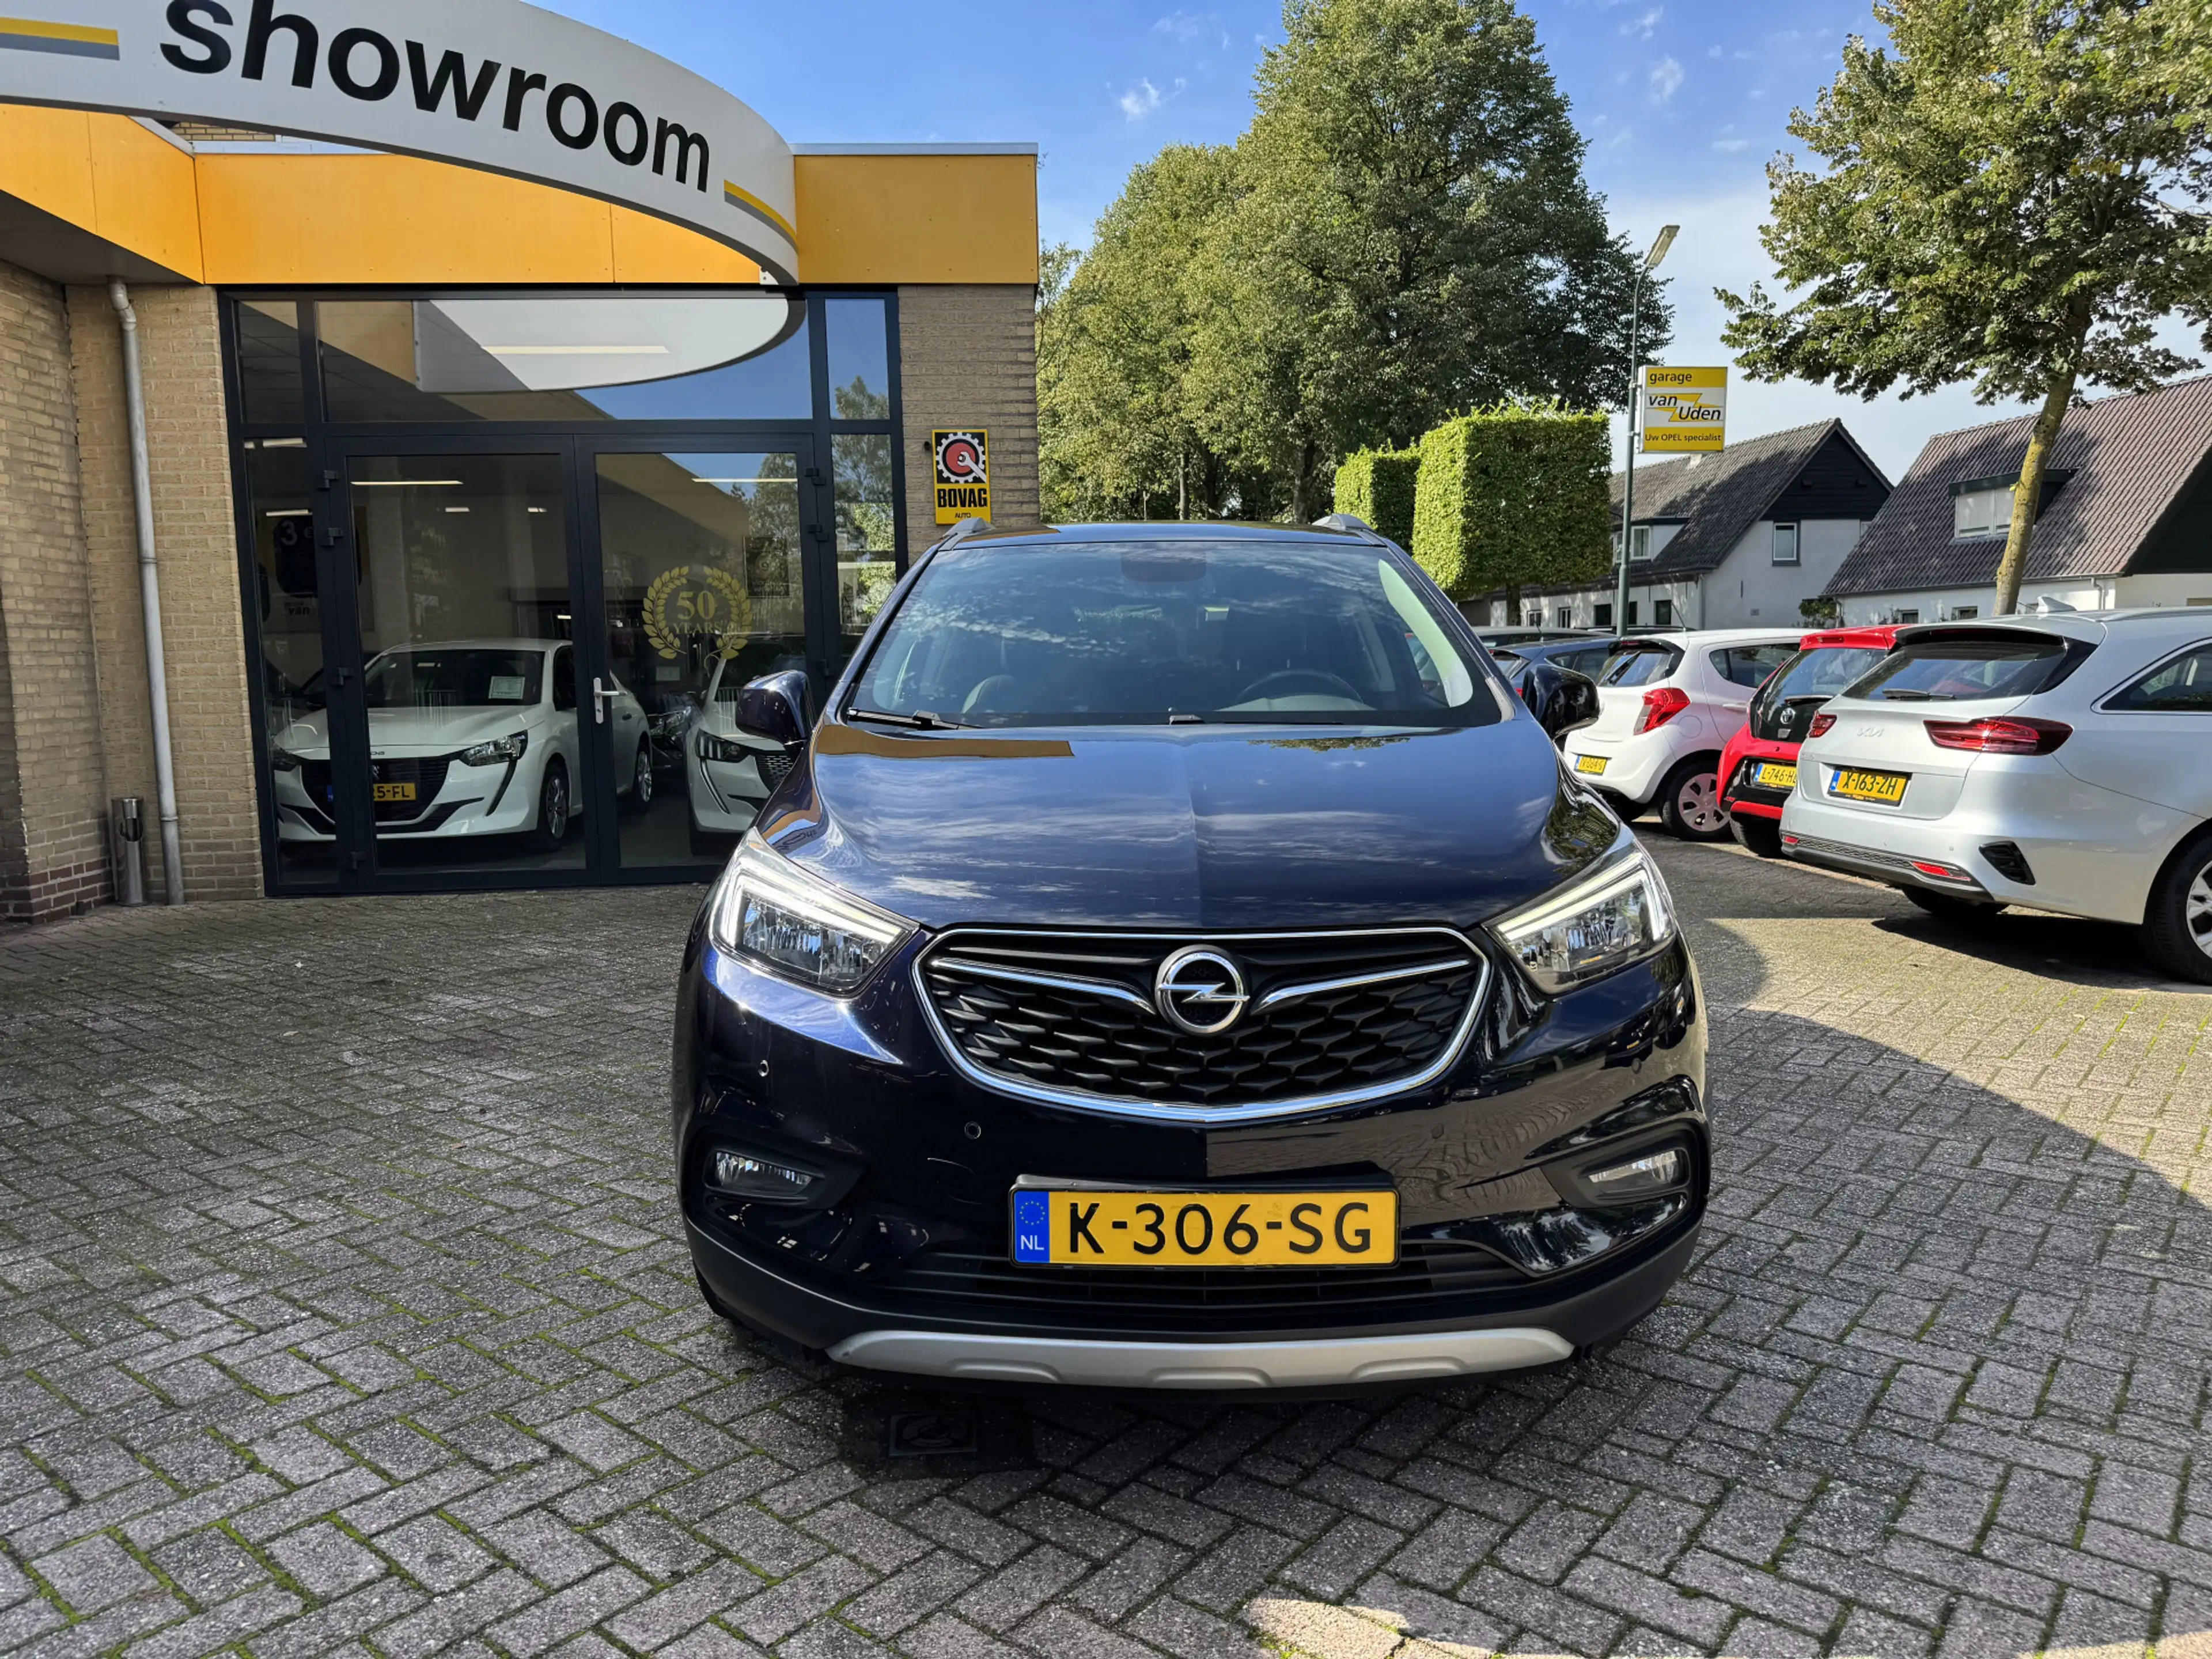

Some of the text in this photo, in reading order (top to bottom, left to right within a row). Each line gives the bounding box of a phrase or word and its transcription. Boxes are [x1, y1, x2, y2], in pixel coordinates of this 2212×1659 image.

[160, 0, 710, 192] showroom
[1650, 373, 1692, 384] garage
[1648, 396, 1677, 407] van
[1679, 406, 1721, 421] Uden
[1684, 433, 1721, 442] specialist
[937, 488, 988, 507] BOVAG
[676, 590, 716, 620] 50
[672, 623, 722, 634] YEARS
[1842, 771, 1898, 796] X-163-ZH
[372, 785, 410, 799] 5-FL
[1070, 1201, 1371, 1256] K-306-SG
[1020, 1234, 1045, 1251] NL
